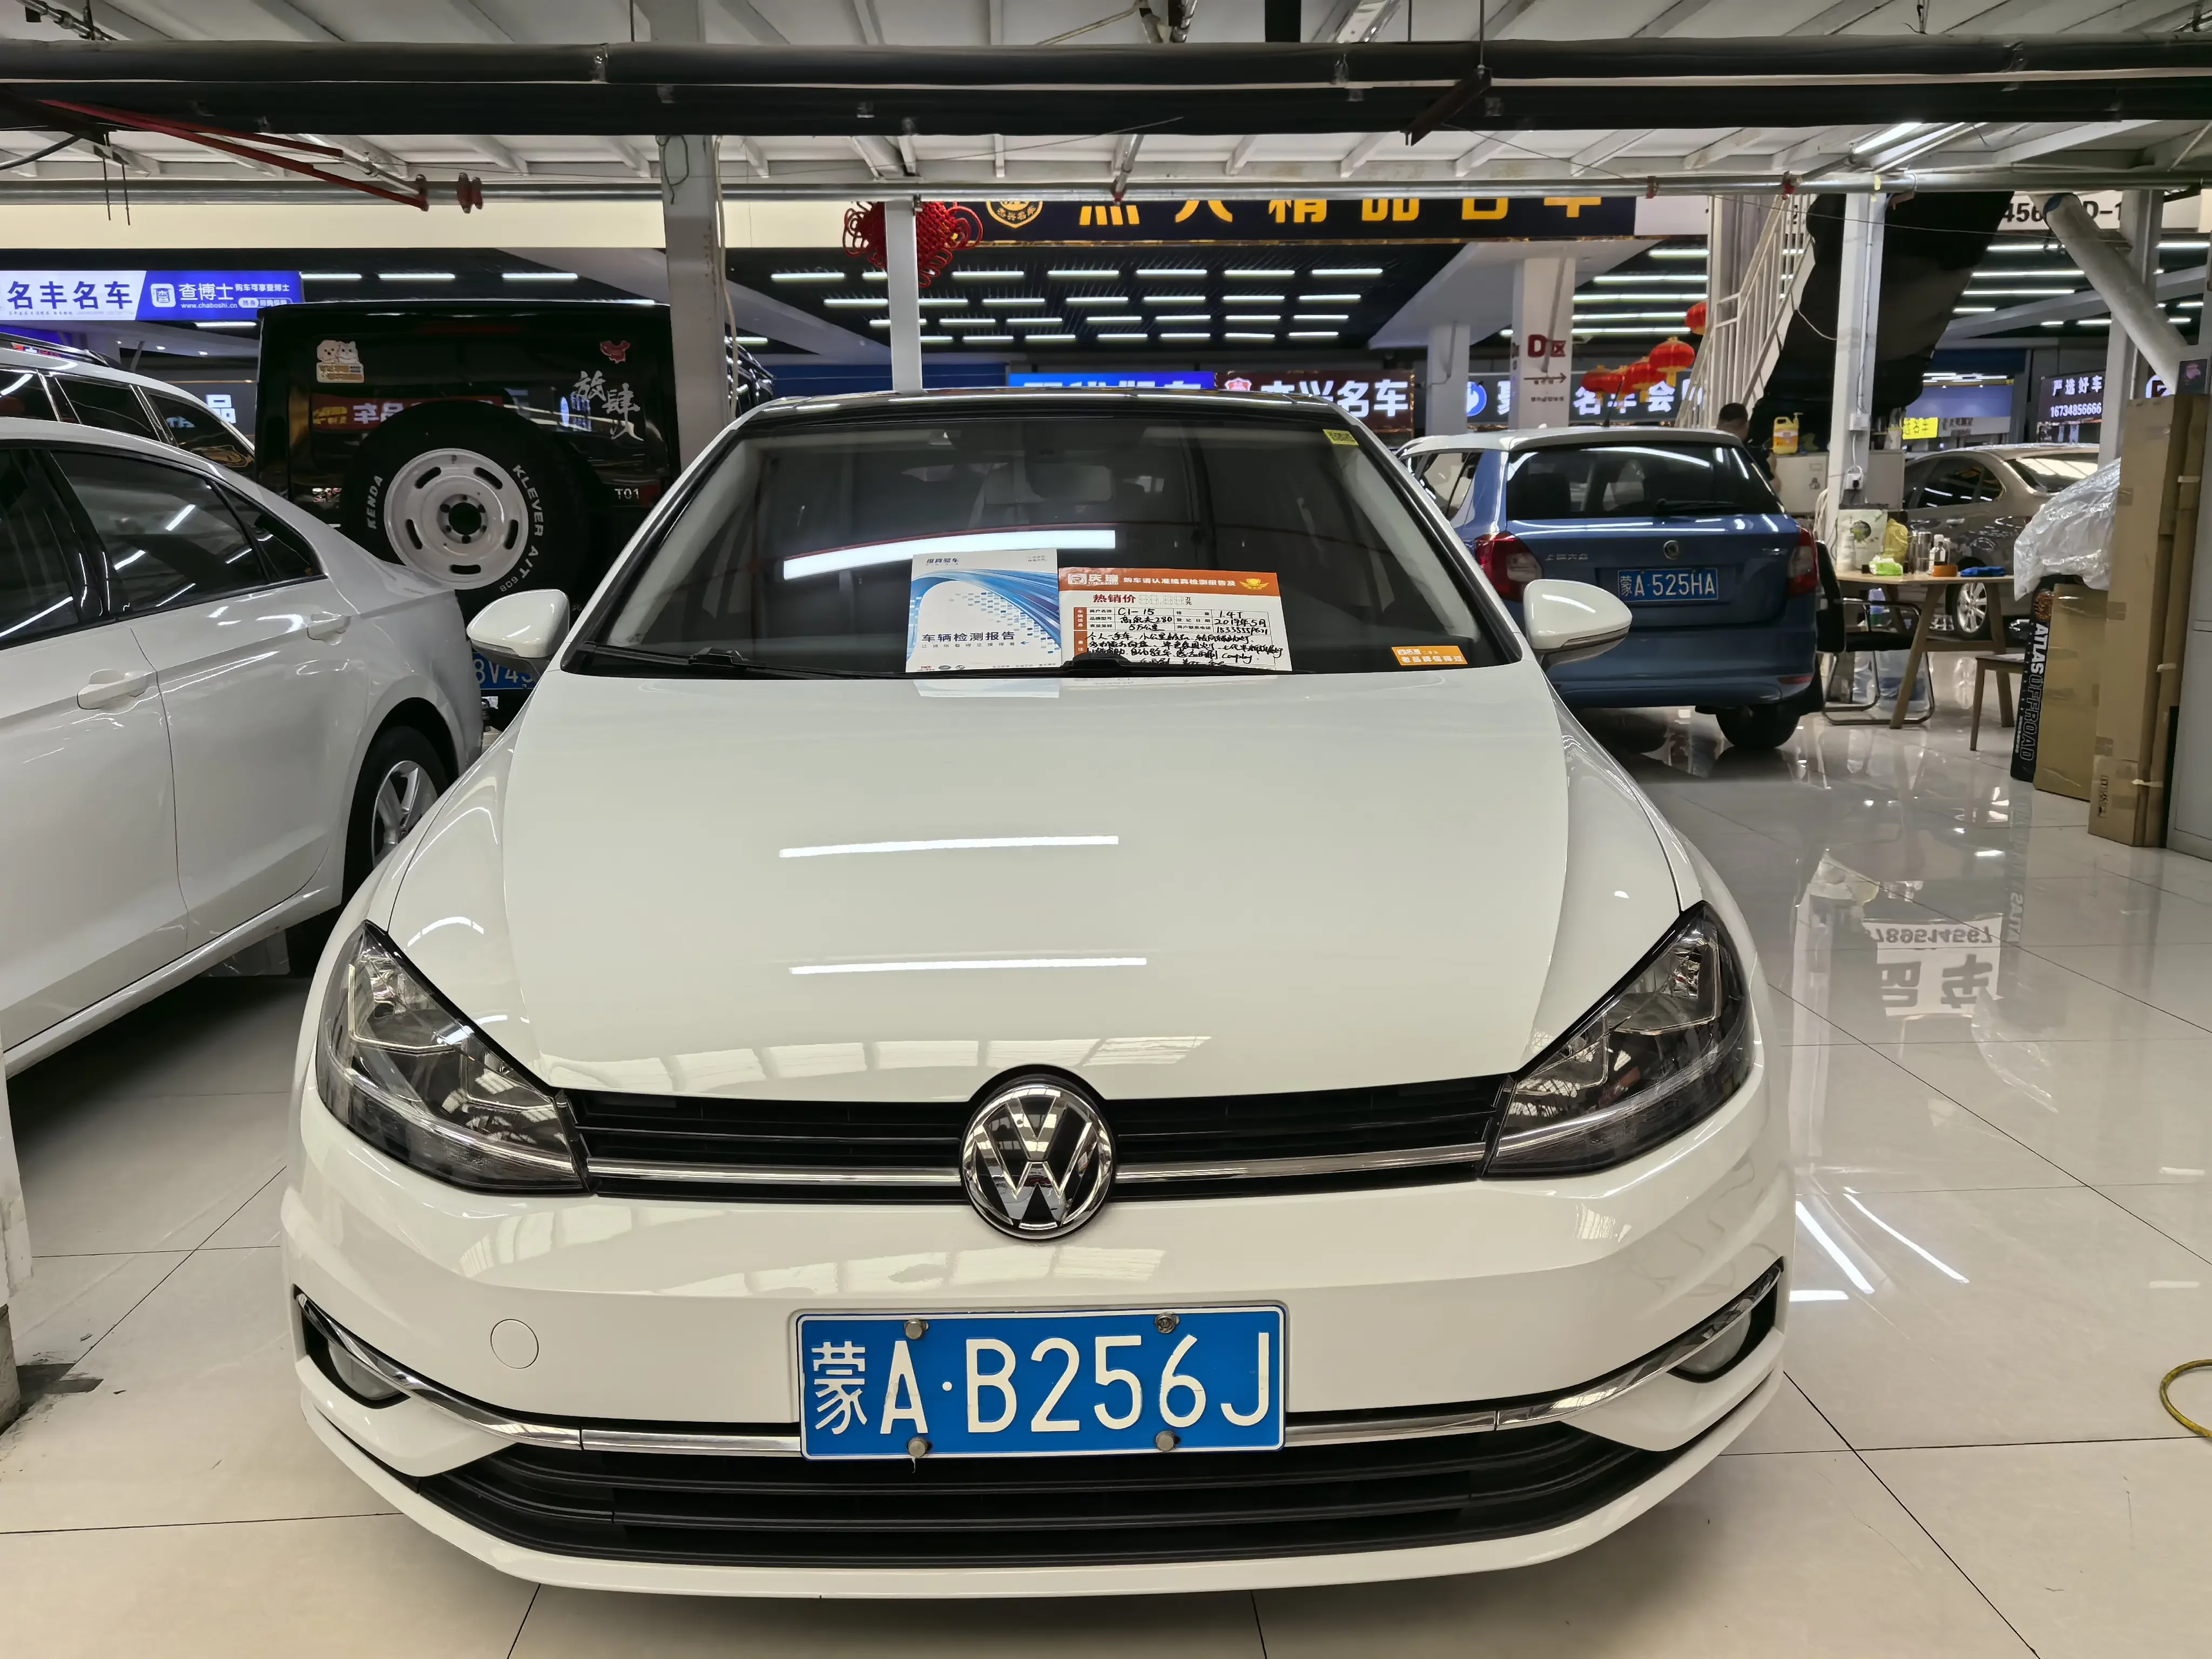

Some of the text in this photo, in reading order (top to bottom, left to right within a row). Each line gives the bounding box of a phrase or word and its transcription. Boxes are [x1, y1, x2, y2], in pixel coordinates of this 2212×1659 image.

[7, 281, 133, 309] 名丰名车
[178, 283, 234, 301] 查博士
[2053, 375, 2103, 397] 严选好车
[2051, 403, 2102, 417] 16734856666
[367, 476, 383, 529] KENDA
[513, 464, 544, 536] KLEVER
[615, 488, 640, 500] T01
[1092, 594, 1136, 604] 热销价
[921, 631, 1015, 642] 车辆检测报告
[2020, 623, 2049, 761] ATLAS OFFROAD
[811, 1331, 1271, 1435] 蒙A·B256J
